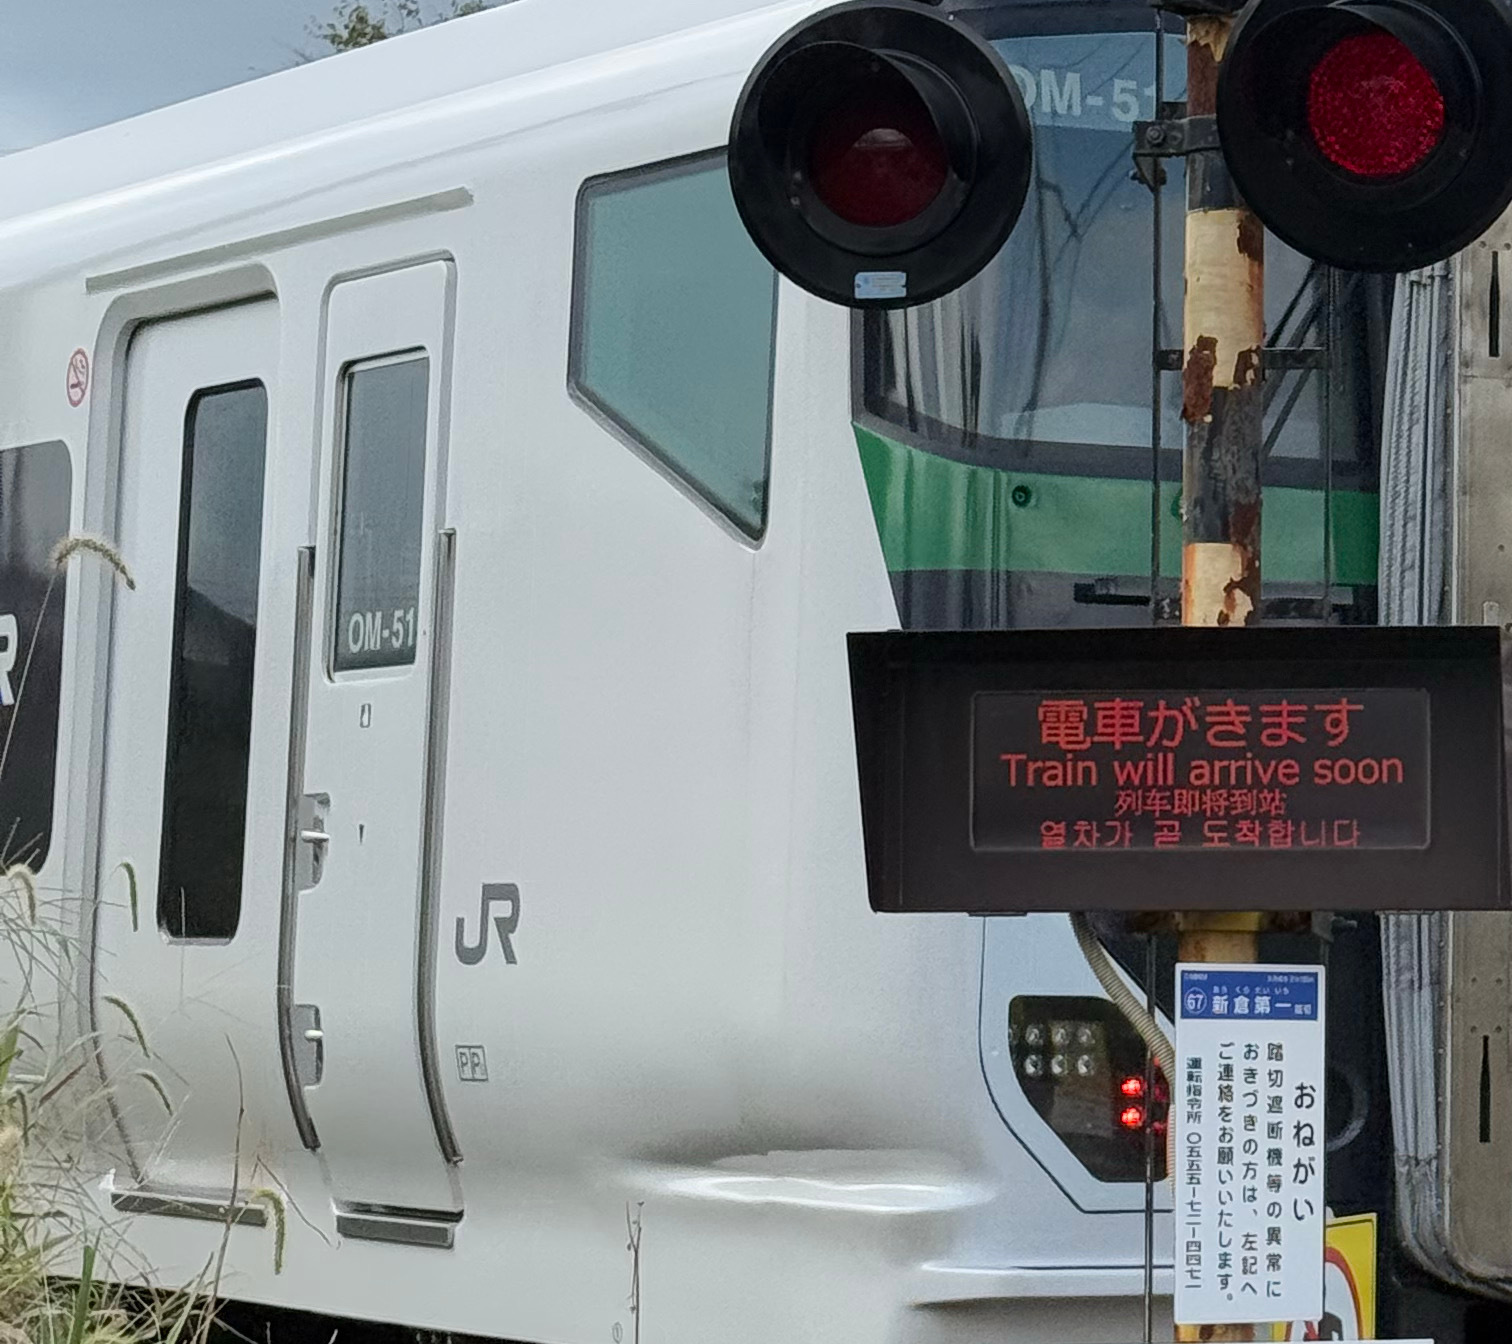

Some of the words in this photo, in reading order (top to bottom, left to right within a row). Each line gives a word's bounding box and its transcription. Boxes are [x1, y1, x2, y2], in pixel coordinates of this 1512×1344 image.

[348, 607, 415, 654] OM-51
[1037, 696, 1365, 752] 電車がきます
[1000, 752, 1097, 787] Train
[1113, 752, 1175, 787] will
[1188, 752, 1301, 786] arrive
[1313, 755, 1404, 785] soon
[1114, 789, 1287, 817] 列车即将到站
[1040, 820, 1133, 849] 열차가
[1202, 819, 1361, 849] 도착합니다
[455, 882, 521, 966] JR
[1186, 994, 1204, 1011] 67
[1292, 1081, 1316, 1221] おねがい
